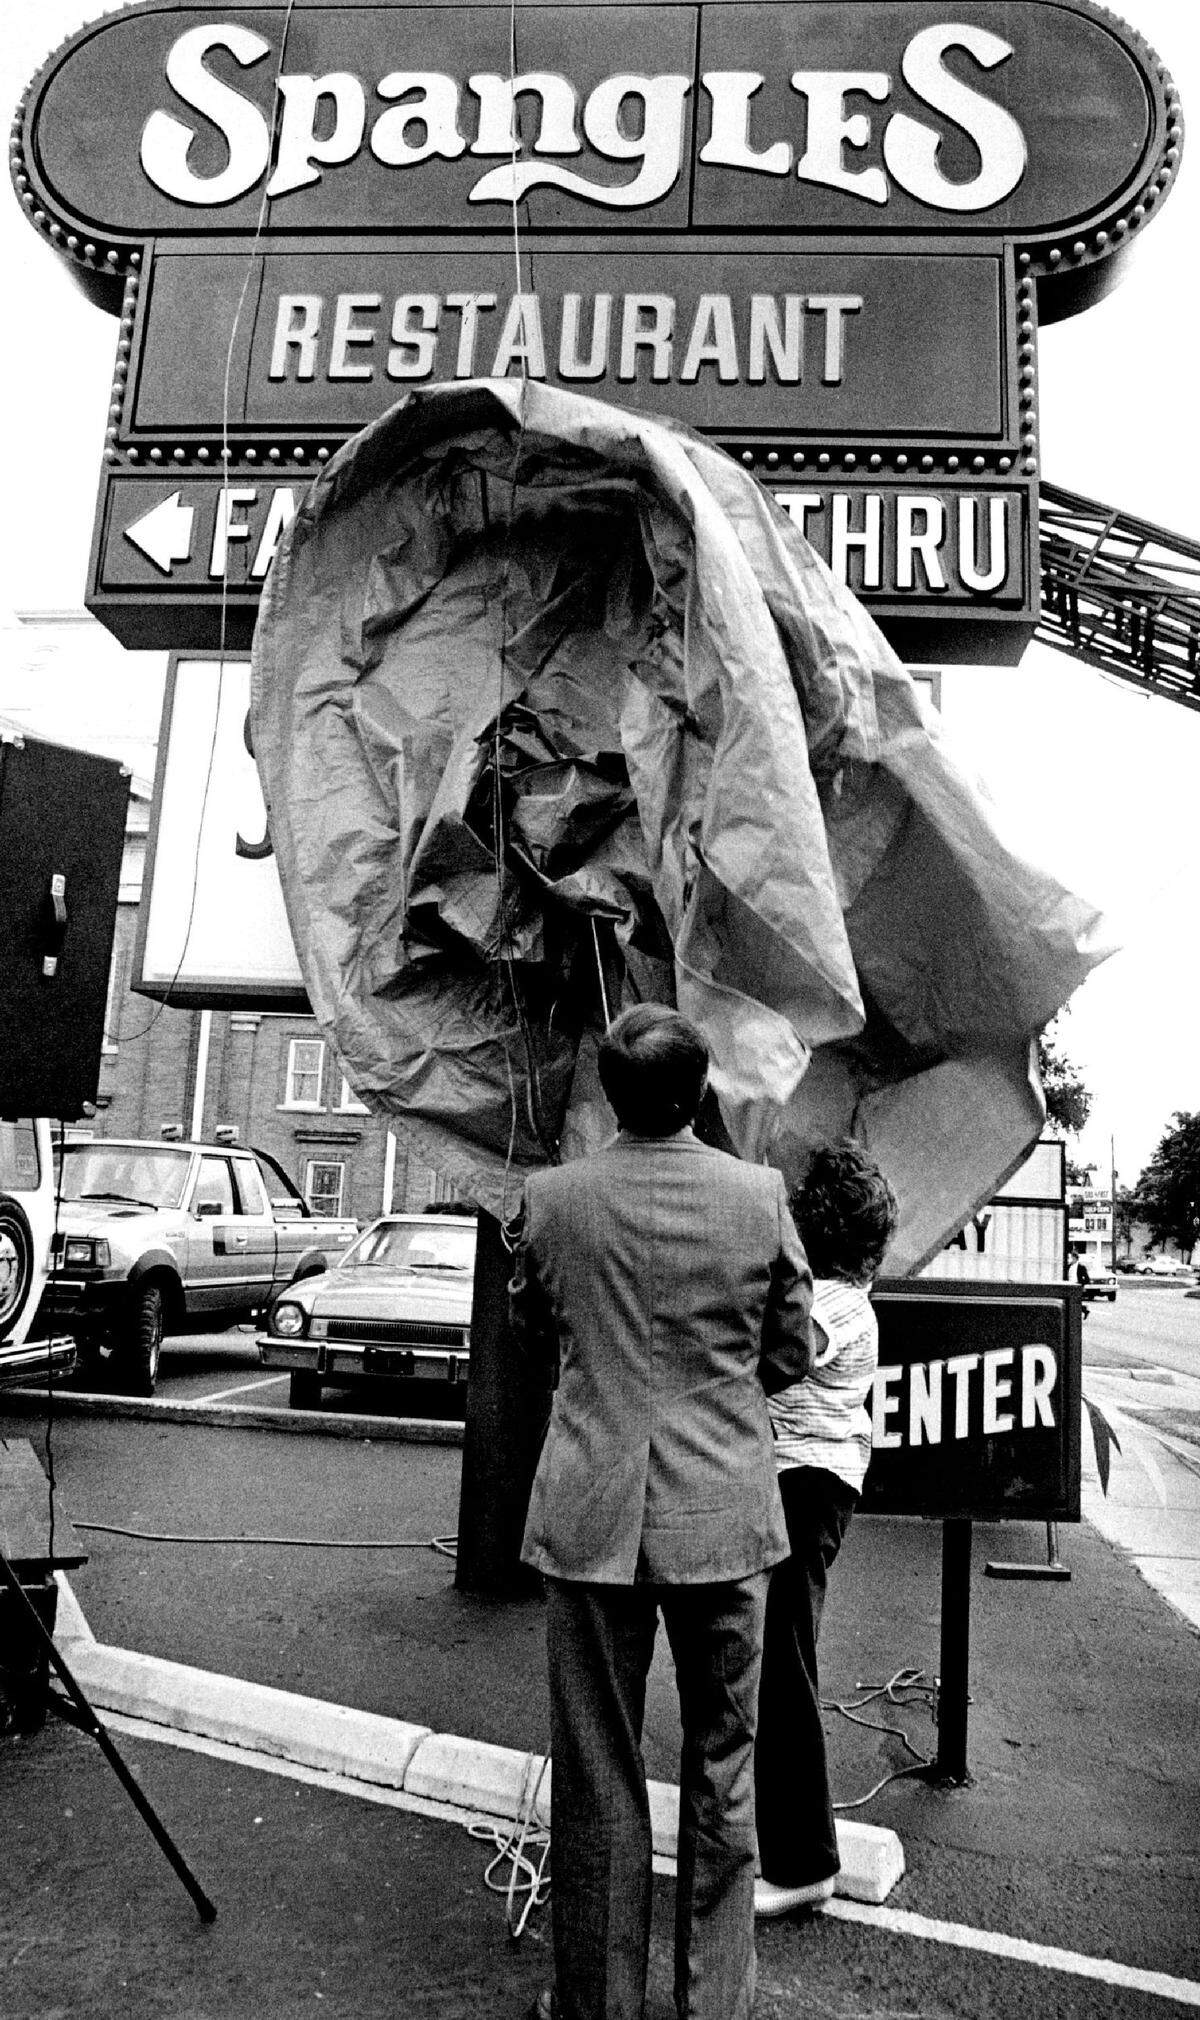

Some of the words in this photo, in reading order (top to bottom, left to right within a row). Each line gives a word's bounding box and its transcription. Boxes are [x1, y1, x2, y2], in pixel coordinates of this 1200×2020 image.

[269, 294, 863, 383] RESTAURANT
[774, 493, 1006, 591] THRU
[871, 1344, 1058, 1449] ENTER
